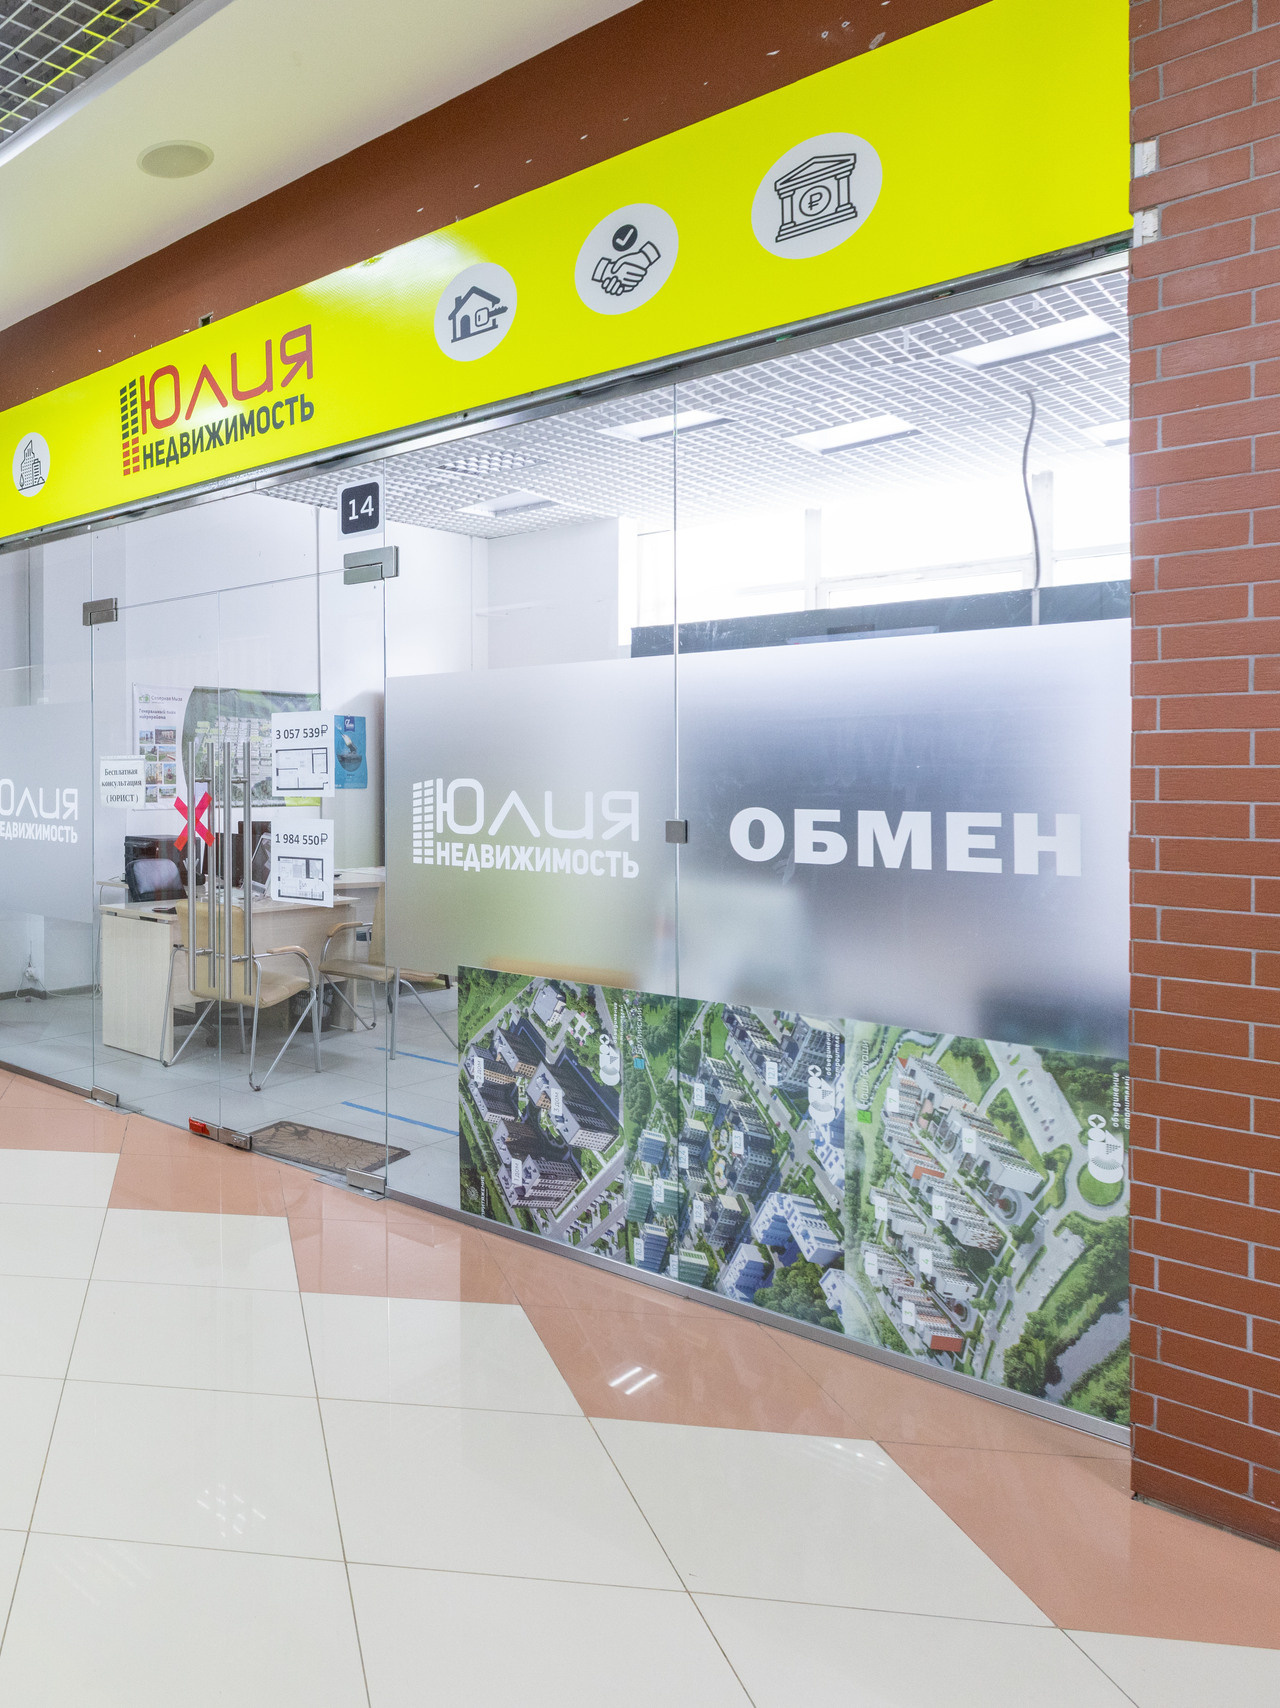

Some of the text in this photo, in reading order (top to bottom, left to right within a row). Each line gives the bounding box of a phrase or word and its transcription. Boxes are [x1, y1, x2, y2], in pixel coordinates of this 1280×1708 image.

[143, 394, 315, 470] НЕДВИЖИМОСТЬ
[348, 496, 374, 521] 14
[275, 729, 282, 740] 3
[283, 728, 301, 739] 057
[101, 779, 142, 788] консультация
[104, 768, 138, 777] Бесплатная
[275, 833, 280, 844] 1
[282, 833, 300, 845] 984
[728, 806, 1082, 878] ОБМЕН
[435, 841, 640, 879] НЕДВИЖИМОСТЬ
[1111, 1072, 1121, 1128] объединение
